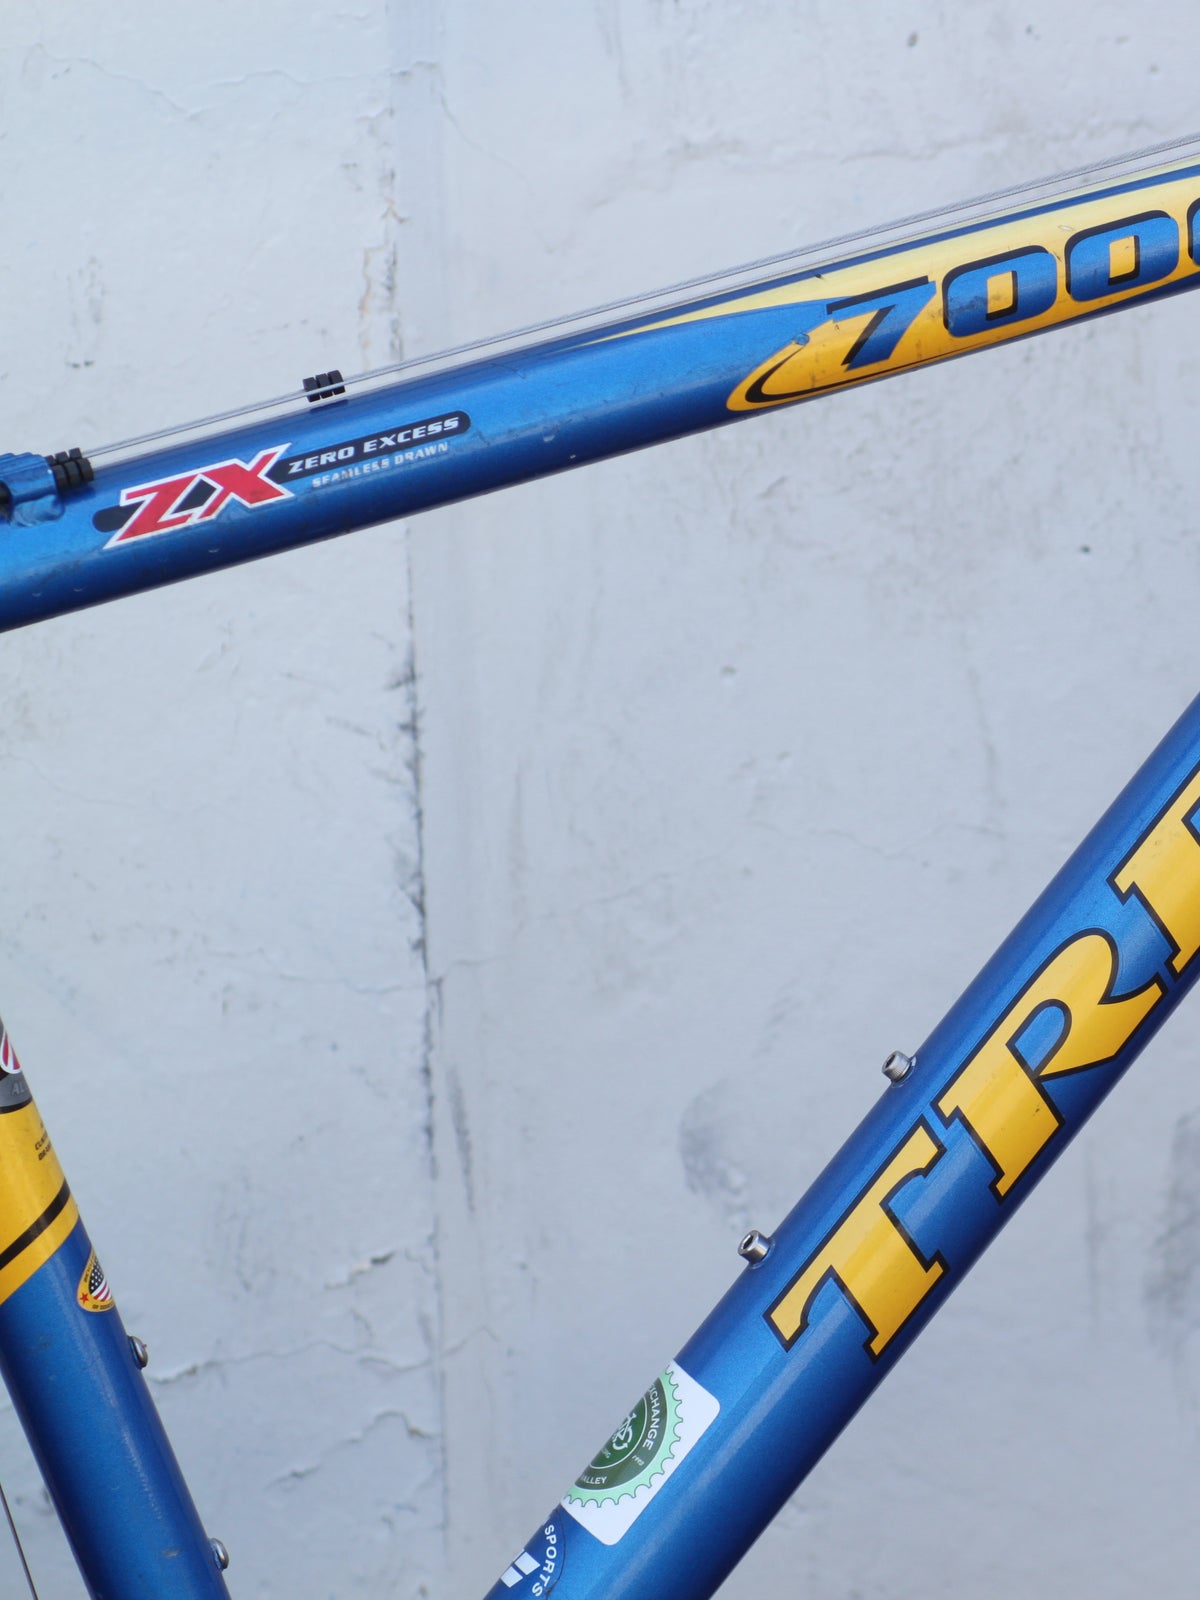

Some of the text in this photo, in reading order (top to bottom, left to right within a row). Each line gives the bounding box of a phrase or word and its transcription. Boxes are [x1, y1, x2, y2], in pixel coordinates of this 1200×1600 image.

[287, 416, 460, 475] ZERO EXCESS
[311, 441, 449, 488] SEAMLESS DRAWN
[103, 442, 295, 550] ZX
[531, 1524, 558, 1597] SPORTS
